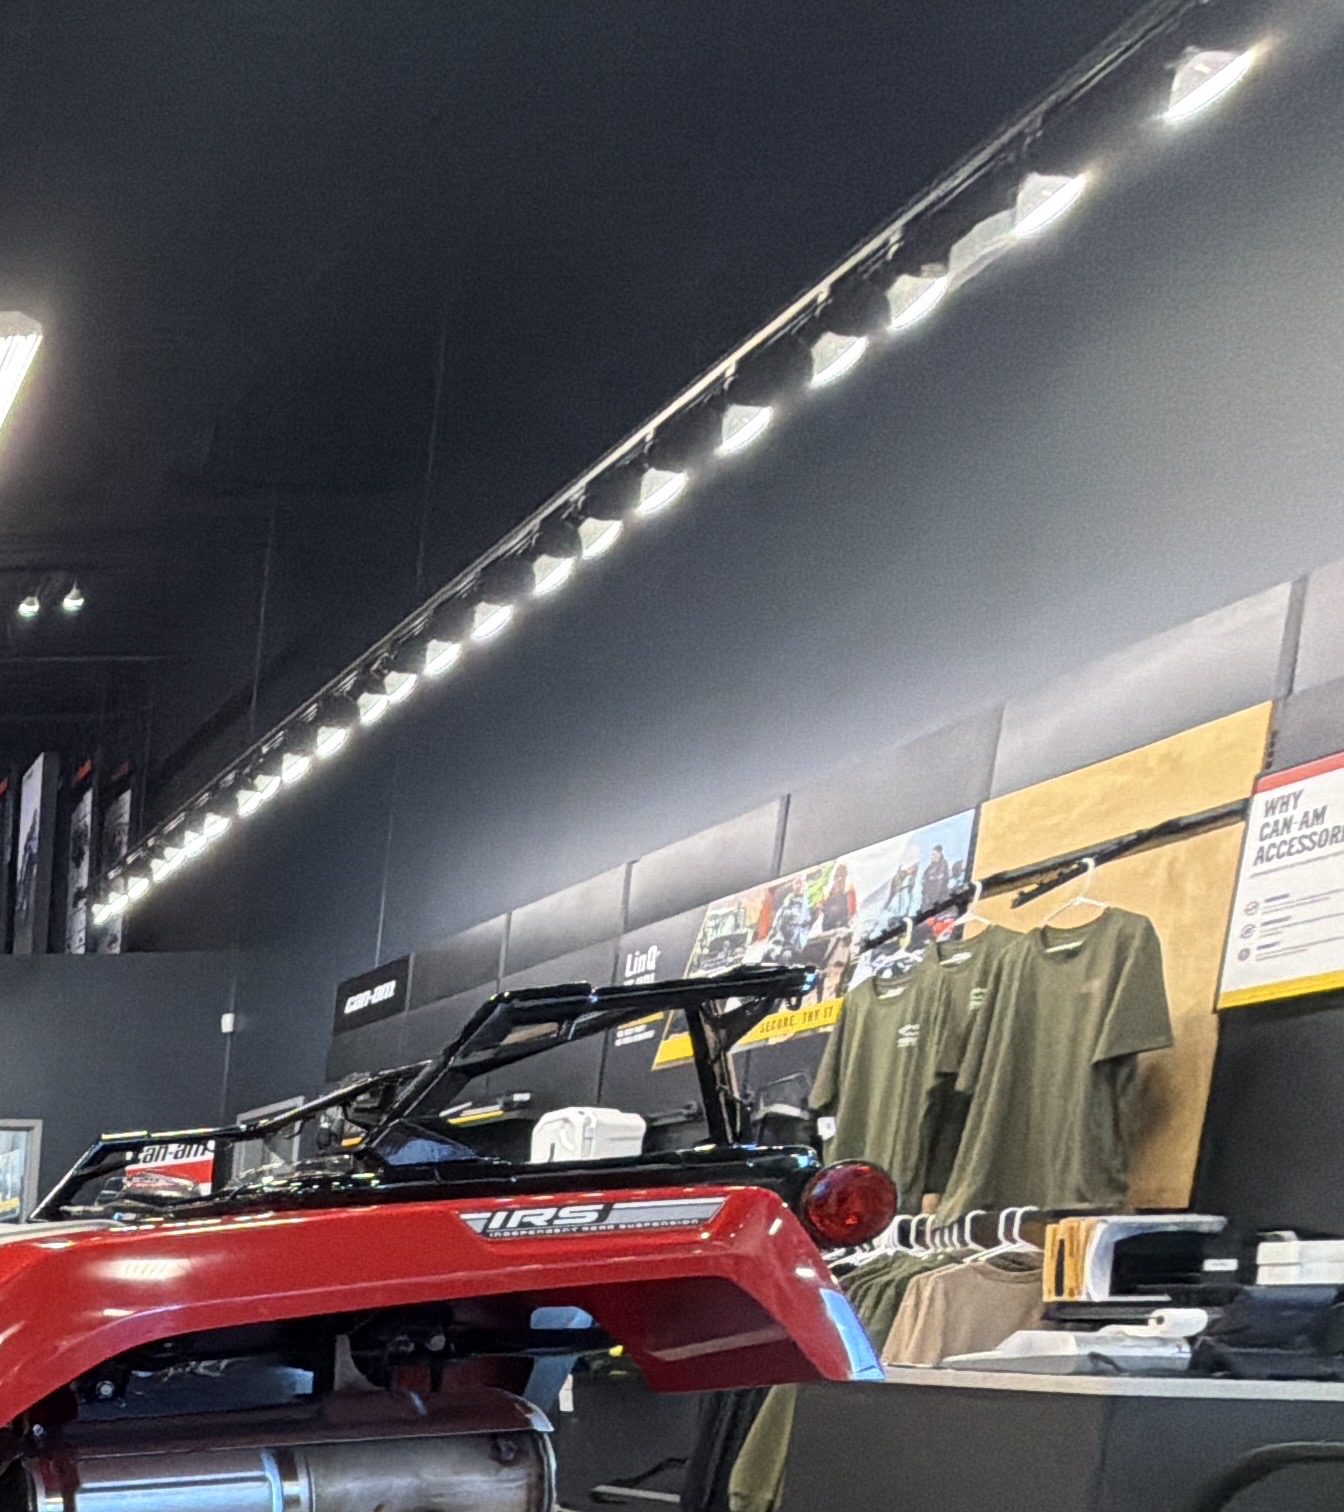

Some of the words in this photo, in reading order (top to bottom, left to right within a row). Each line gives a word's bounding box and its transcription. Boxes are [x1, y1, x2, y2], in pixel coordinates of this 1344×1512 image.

[1264, 788, 1304, 818] WHY
[1258, 804, 1329, 842] CAN-AM
[343, 979, 397, 1015] can-am
[488, 1204, 605, 1229] IRS
